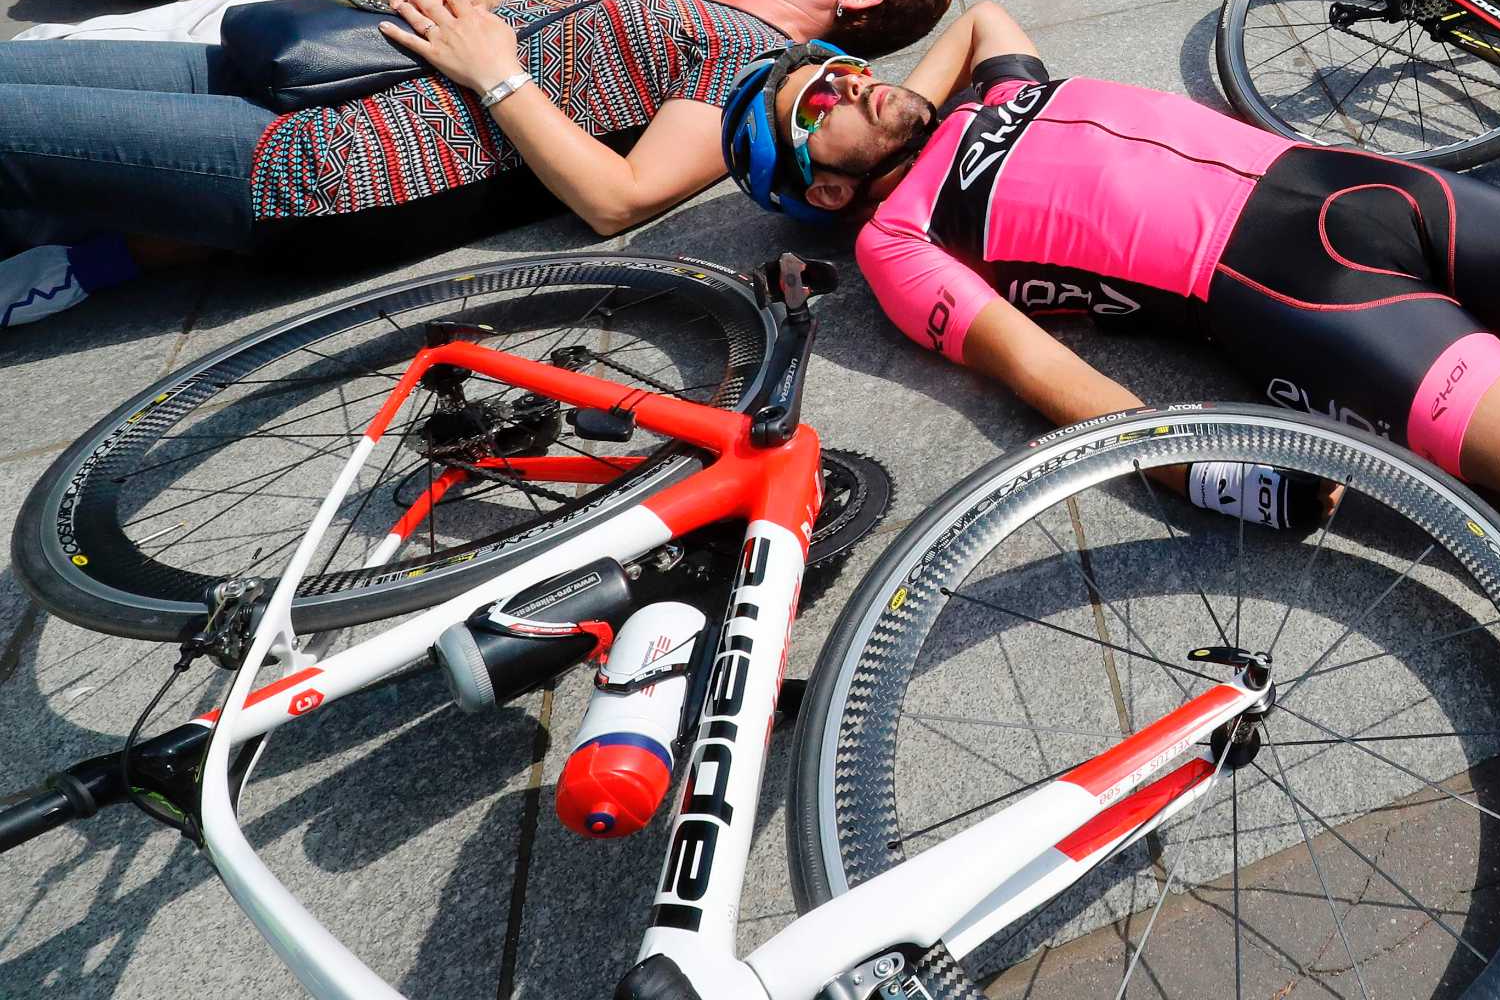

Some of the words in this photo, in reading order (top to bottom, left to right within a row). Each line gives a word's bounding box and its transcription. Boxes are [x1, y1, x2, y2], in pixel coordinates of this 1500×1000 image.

[1039, 411, 1128, 446] HUTCHINSON
[1167, 403, 1204, 412] ATOM
[999, 436, 1119, 495] CARBONE
[56, 498, 79, 555] COSMIC
